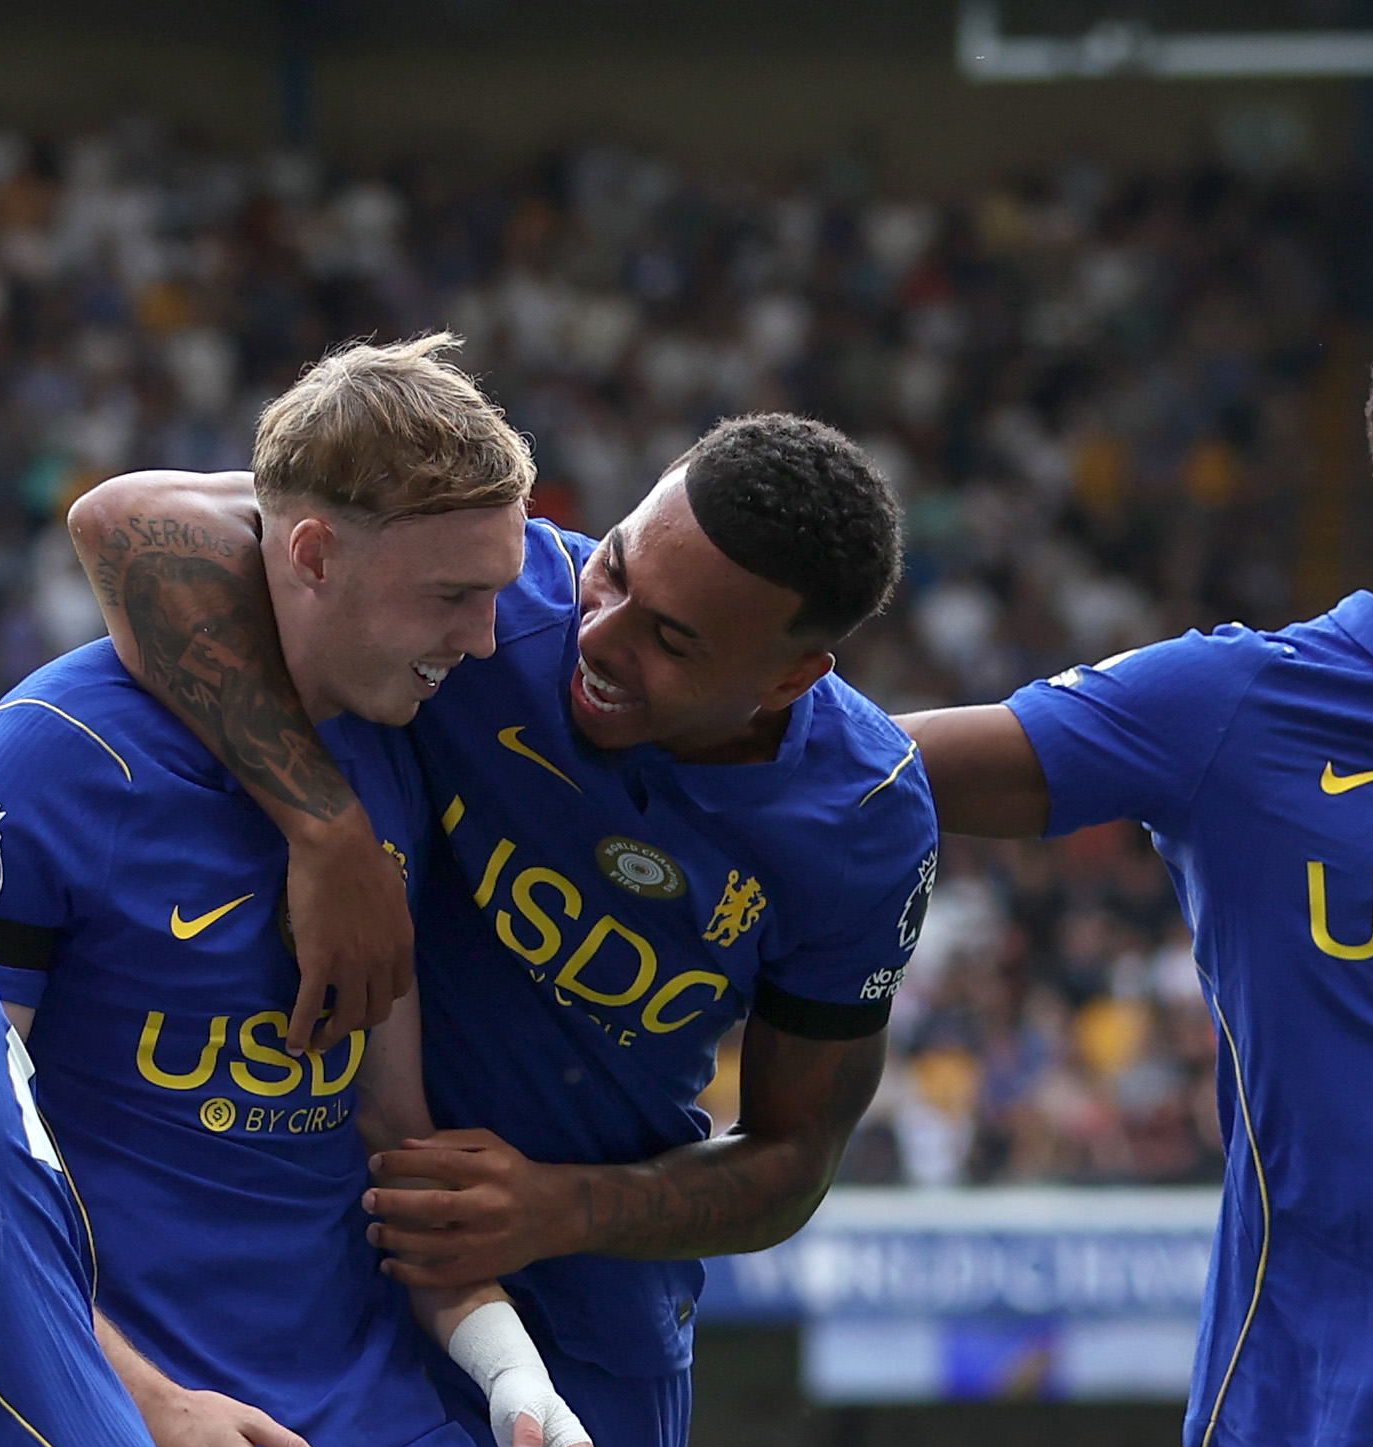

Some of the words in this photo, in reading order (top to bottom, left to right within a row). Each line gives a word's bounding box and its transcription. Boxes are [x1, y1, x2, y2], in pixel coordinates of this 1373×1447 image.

[604, 842, 639, 857] WORLD
[609, 870, 641, 893] FIFA
[245, 1106, 285, 1133] BY
[287, 1099, 349, 1134] CIRL
